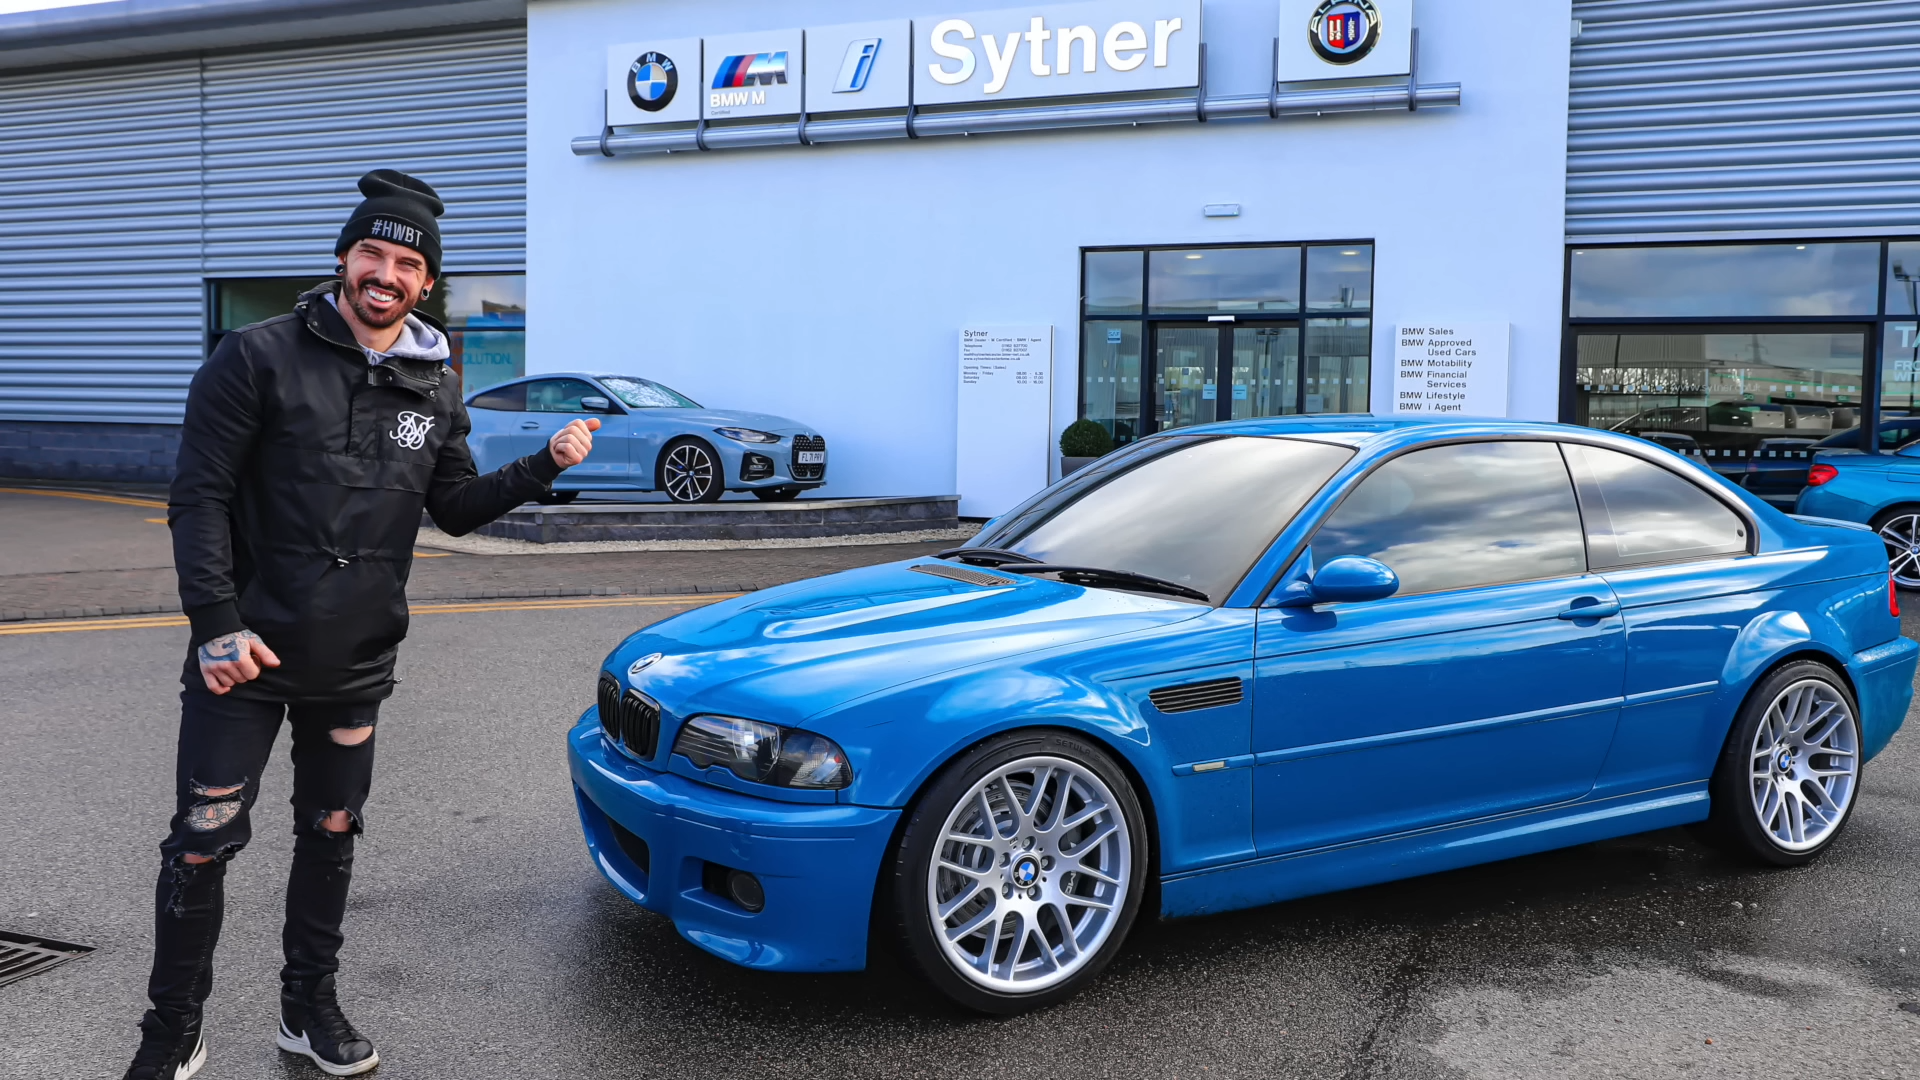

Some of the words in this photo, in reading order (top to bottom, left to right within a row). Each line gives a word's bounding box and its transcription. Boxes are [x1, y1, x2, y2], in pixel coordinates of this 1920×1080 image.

[928, 16, 1182, 94] Sytner
[631, 52, 673, 74] BMW
[710, 91, 749, 108] BMW
[752, 90, 766, 105] M
[371, 219, 423, 247] #HWBT
[963, 329, 989, 338] Sytner
[1401, 327, 1425, 336] BMW
[1428, 327, 1454, 336] Sales
[1401, 339, 1425, 347] BMW
[1427, 338, 1472, 348] Approved
[1427, 348, 1452, 357] Used
[1454, 348, 1477, 357] Cars
[1400, 359, 1424, 367] BMW
[1427, 359, 1473, 369] Motability
[1400, 371, 1424, 379] BMW
[1426, 371, 1468, 379] Financial
[1426, 380, 1467, 389] Services
[1399, 391, 1423, 400] BMW
[1426, 391, 1466, 401] Lifestyle
[1399, 402, 1422, 411] BMW
[1434, 402, 1462, 412] Agent
